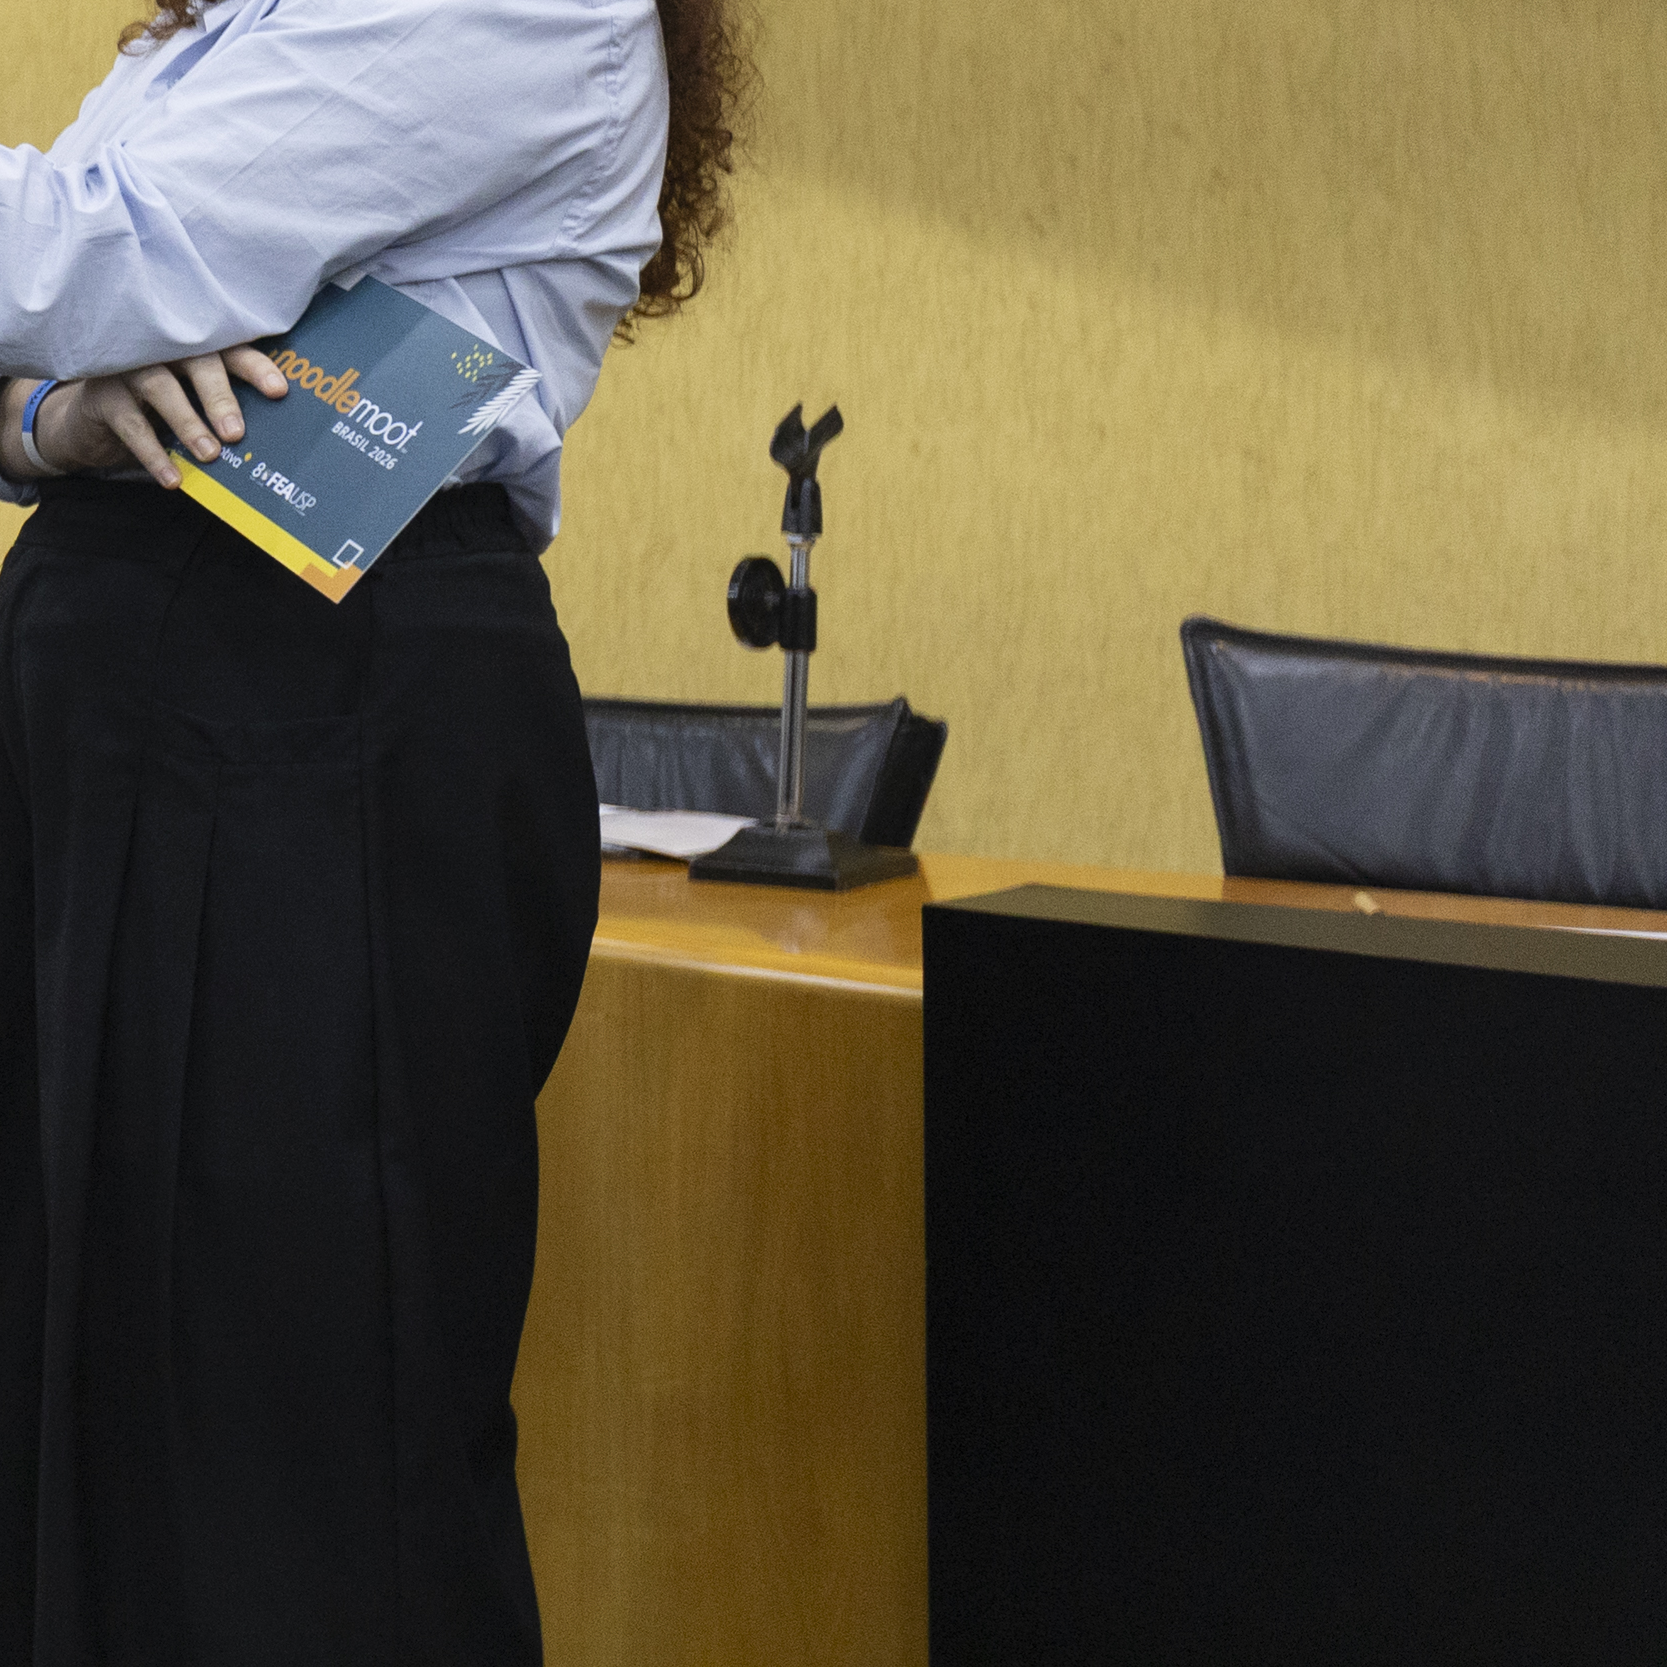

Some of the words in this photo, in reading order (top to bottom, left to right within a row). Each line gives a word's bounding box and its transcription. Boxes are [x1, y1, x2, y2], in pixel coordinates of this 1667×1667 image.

[221, 446, 243, 469] tiva
[331, 421, 370, 453] BRASIL
[368, 446, 398, 470] 2026
